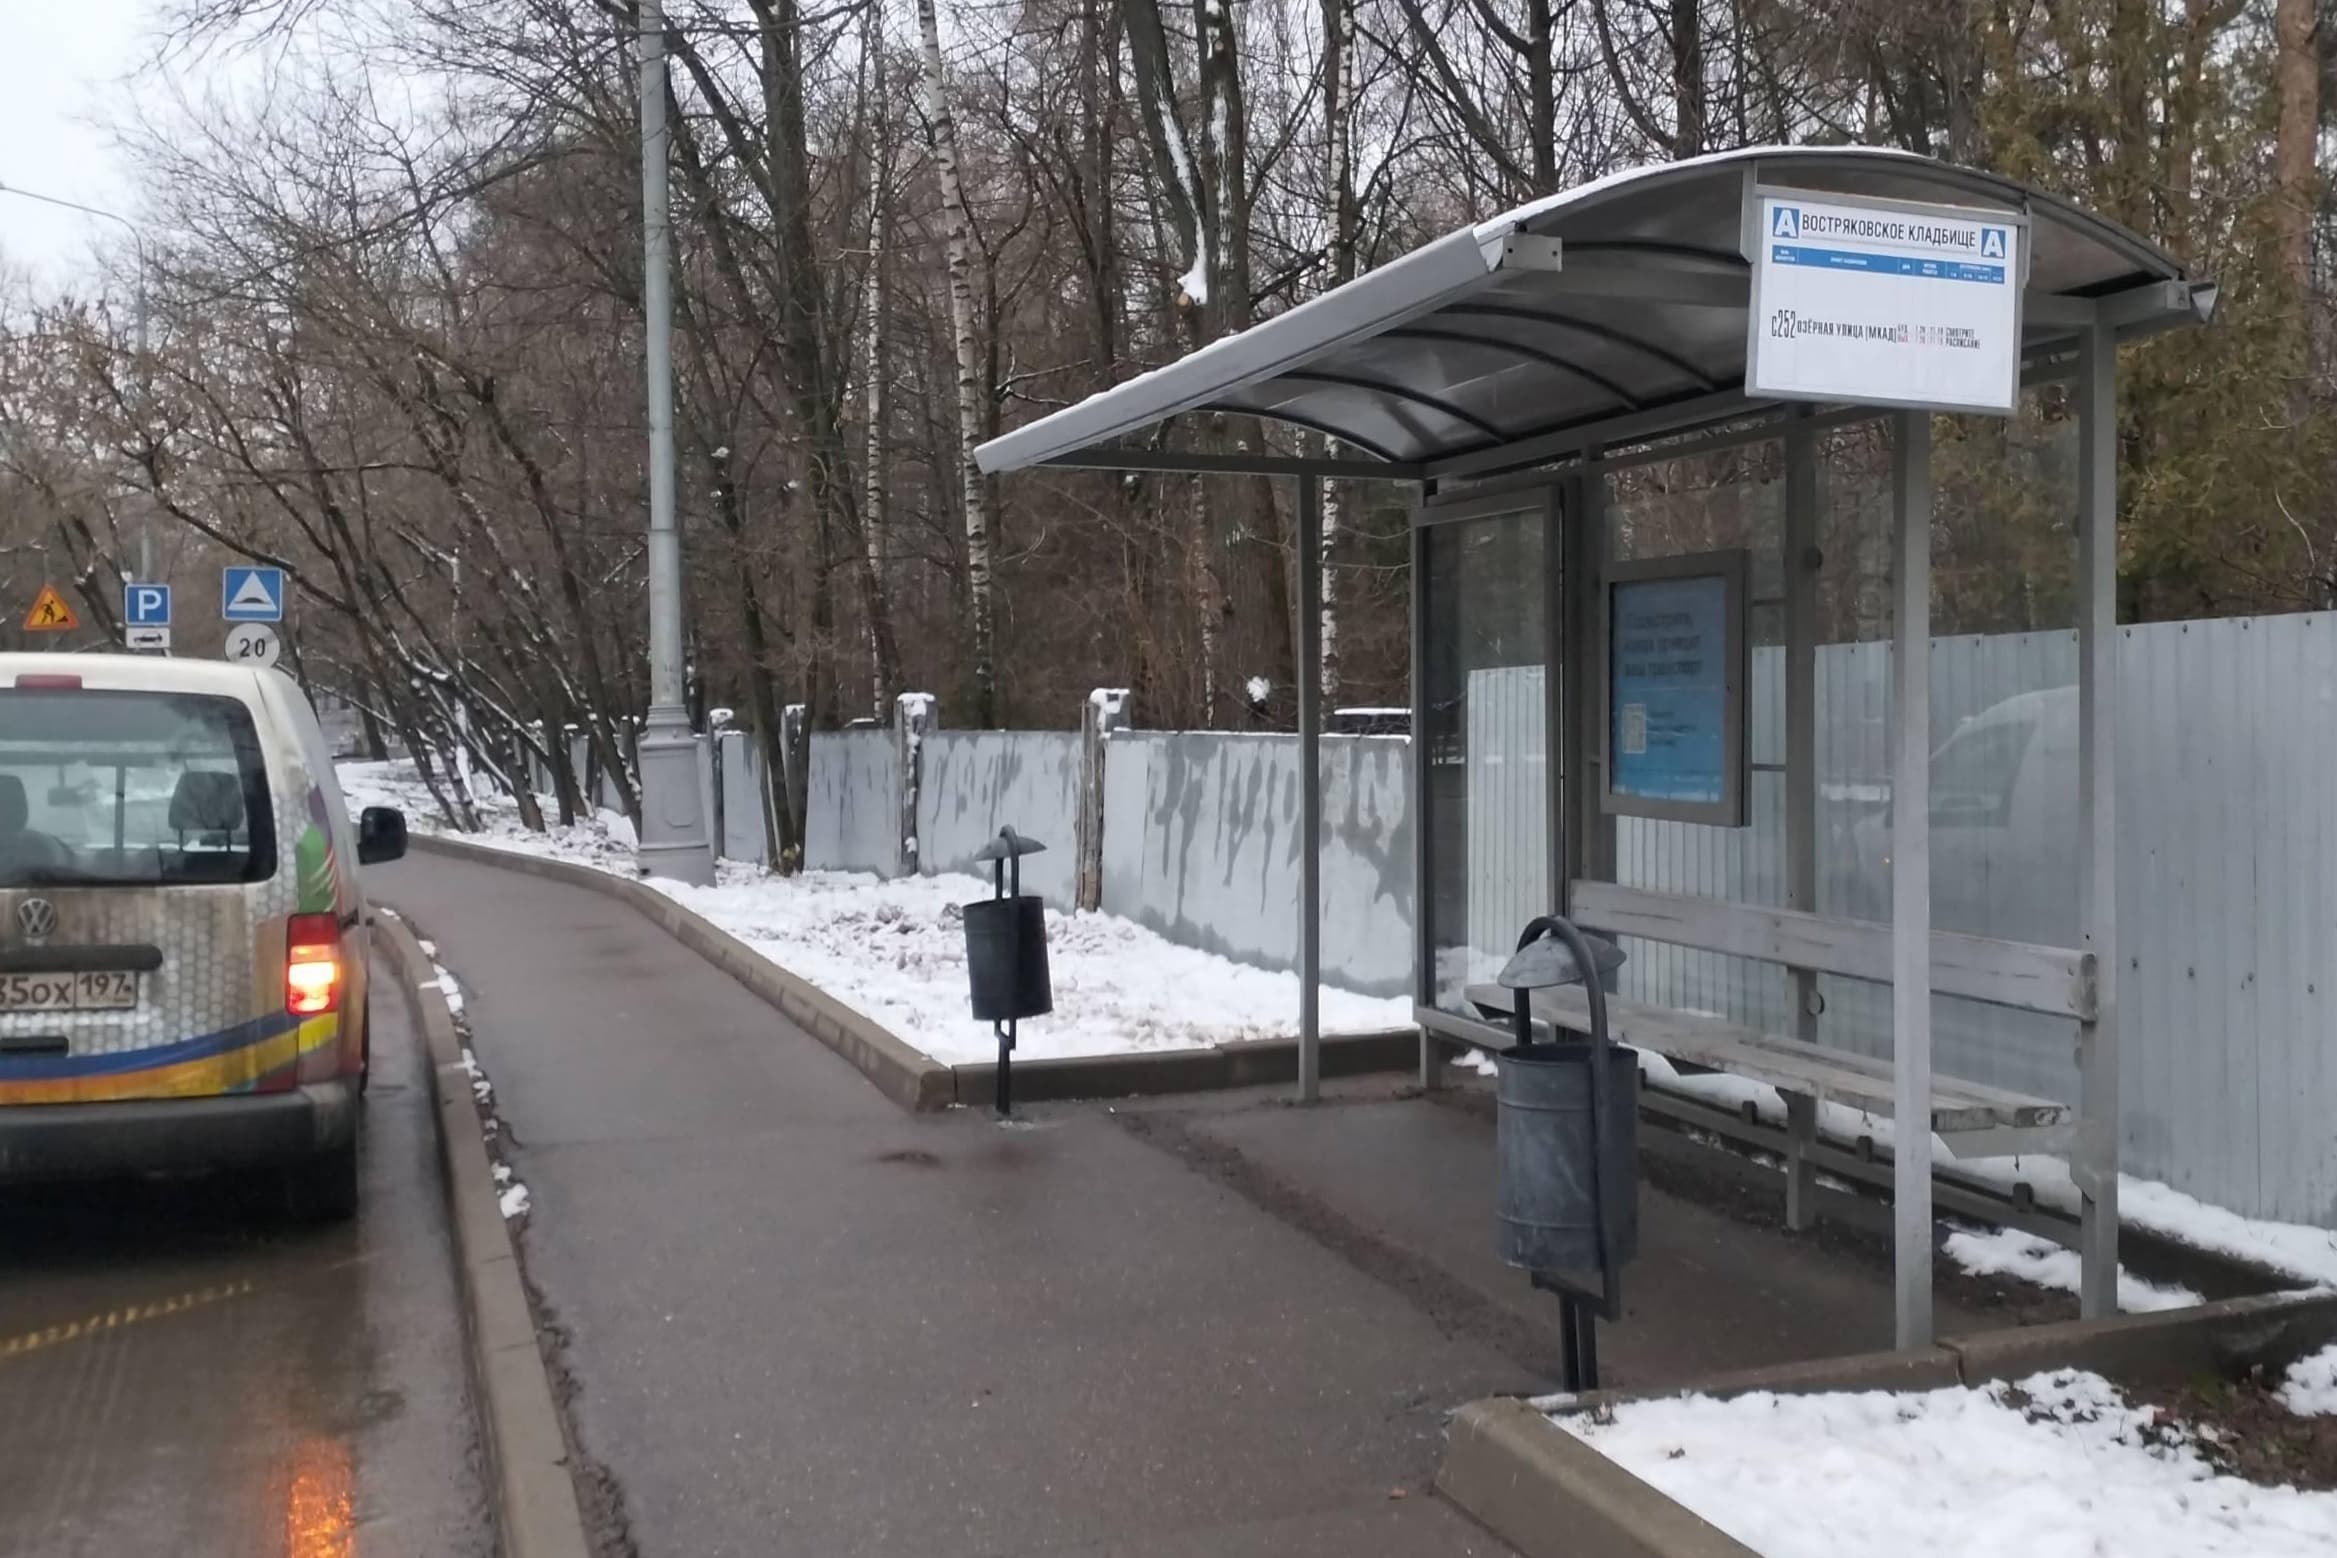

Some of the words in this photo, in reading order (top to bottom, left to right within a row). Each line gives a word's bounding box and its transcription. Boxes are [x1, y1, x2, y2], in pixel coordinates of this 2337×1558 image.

[1802, 214, 1905, 240] ВОСТРЯКОВСКОЕ
[1908, 225, 1976, 249] КЛАДБИЩЕ
[1797, 319, 1834, 336] ОЗЁРНАЯ
[1836, 323, 1864, 339] УЛИЦА
[138, 590, 162, 620] P
[239, 637, 266, 658] 20
